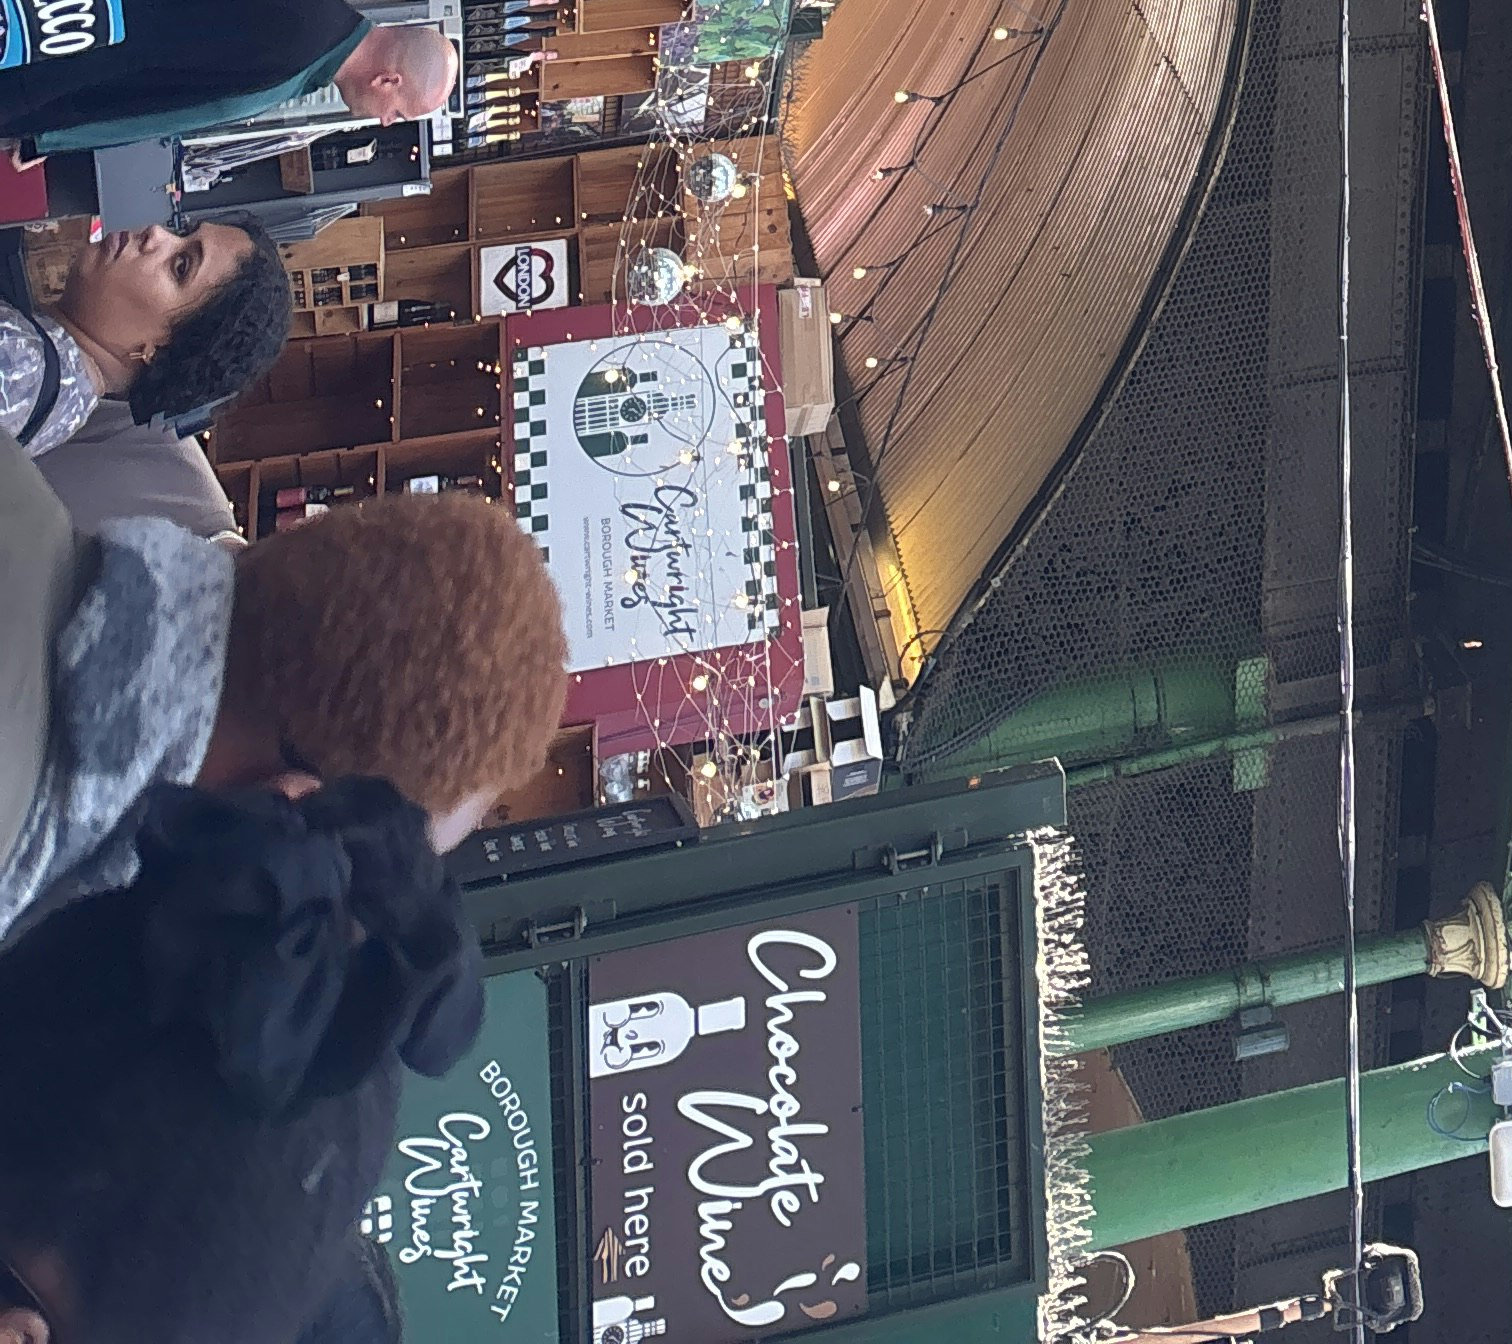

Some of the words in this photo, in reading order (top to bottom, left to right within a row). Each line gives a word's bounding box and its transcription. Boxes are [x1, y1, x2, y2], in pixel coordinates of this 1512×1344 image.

[516, 248, 530, 308] LONDON
[600, 518, 613, 577] BOROUGH
[602, 581, 615, 632] MARKET
[651, 485, 699, 643] Cartwright
[478, 1059, 540, 1191] BOROUGH
[622, 1093, 653, 1174] sold
[747, 930, 836, 1227] Chocolate
[397, 1137, 451, 1264] Wines
[433, 1113, 491, 1295] Cartwright
[624, 1187, 654, 1279] here
[677, 1091, 768, 1300] Wine
[489, 1201, 540, 1323] MARKET
